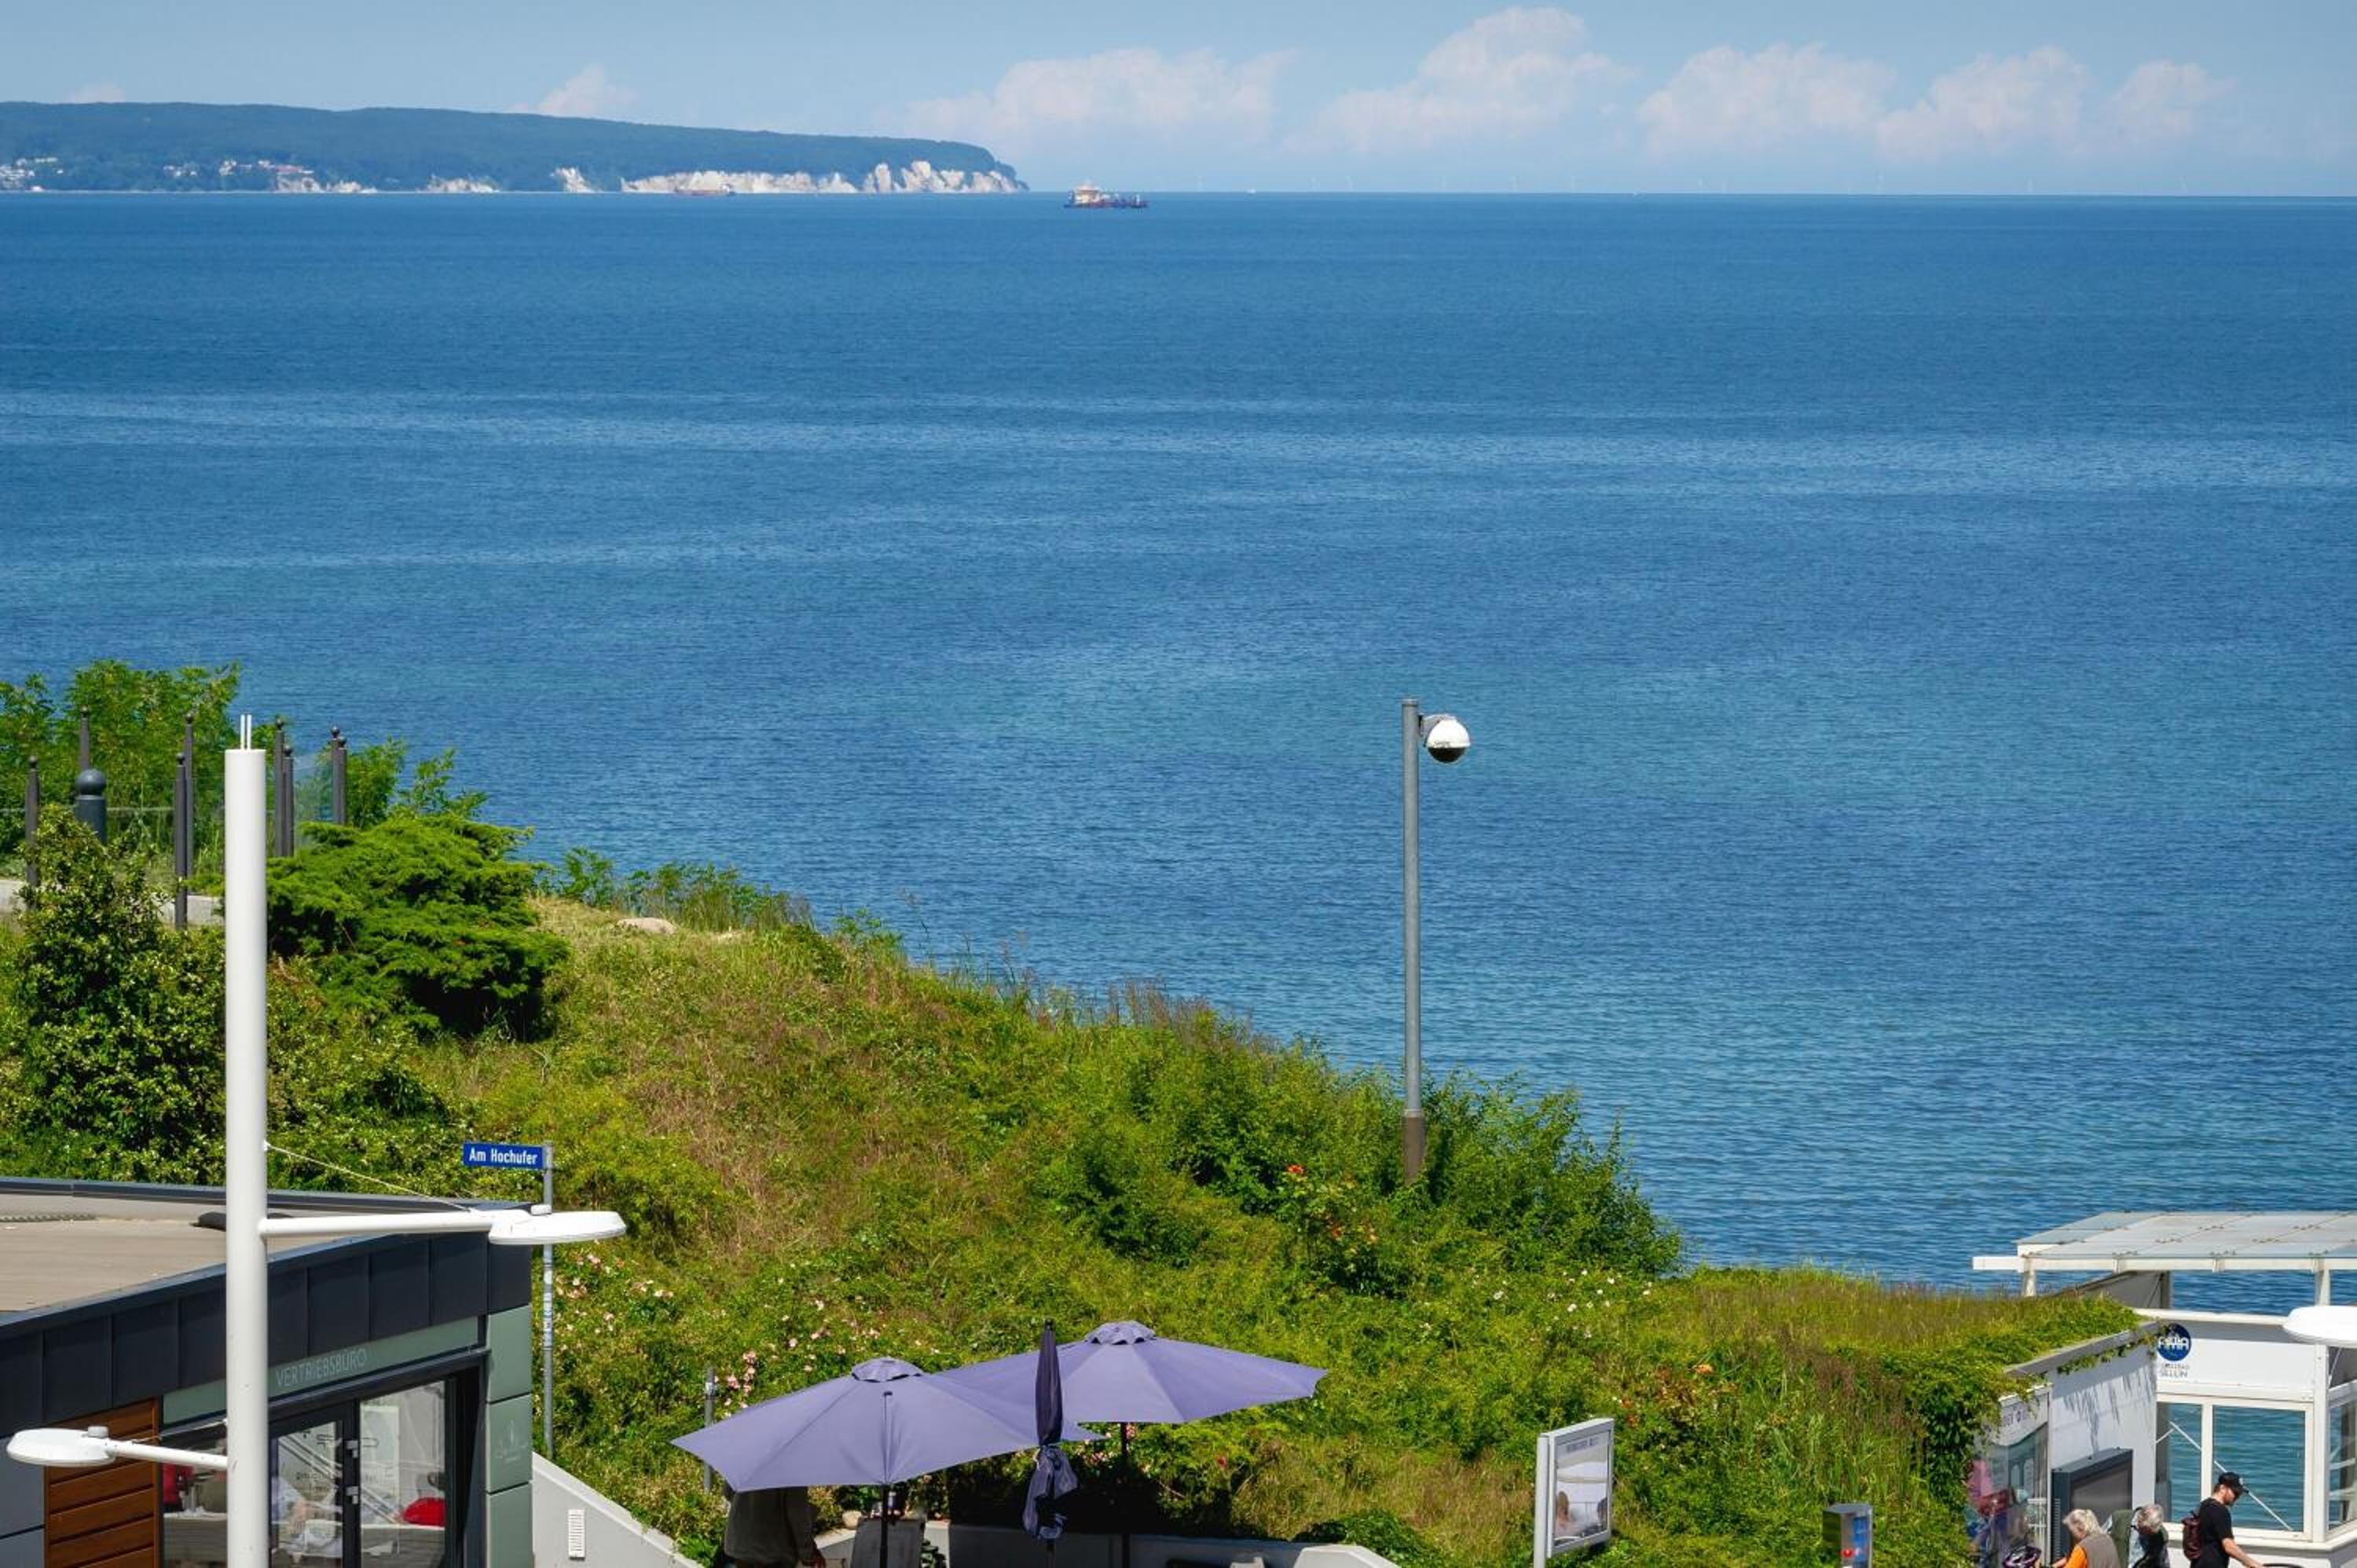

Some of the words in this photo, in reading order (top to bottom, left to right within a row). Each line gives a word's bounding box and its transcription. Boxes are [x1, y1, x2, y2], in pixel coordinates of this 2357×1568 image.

[469, 1147, 486, 1162] Am
[491, 1148, 538, 1164] Hochufer
[276, 1347, 366, 1387] VERTRIEBSBÜRO
